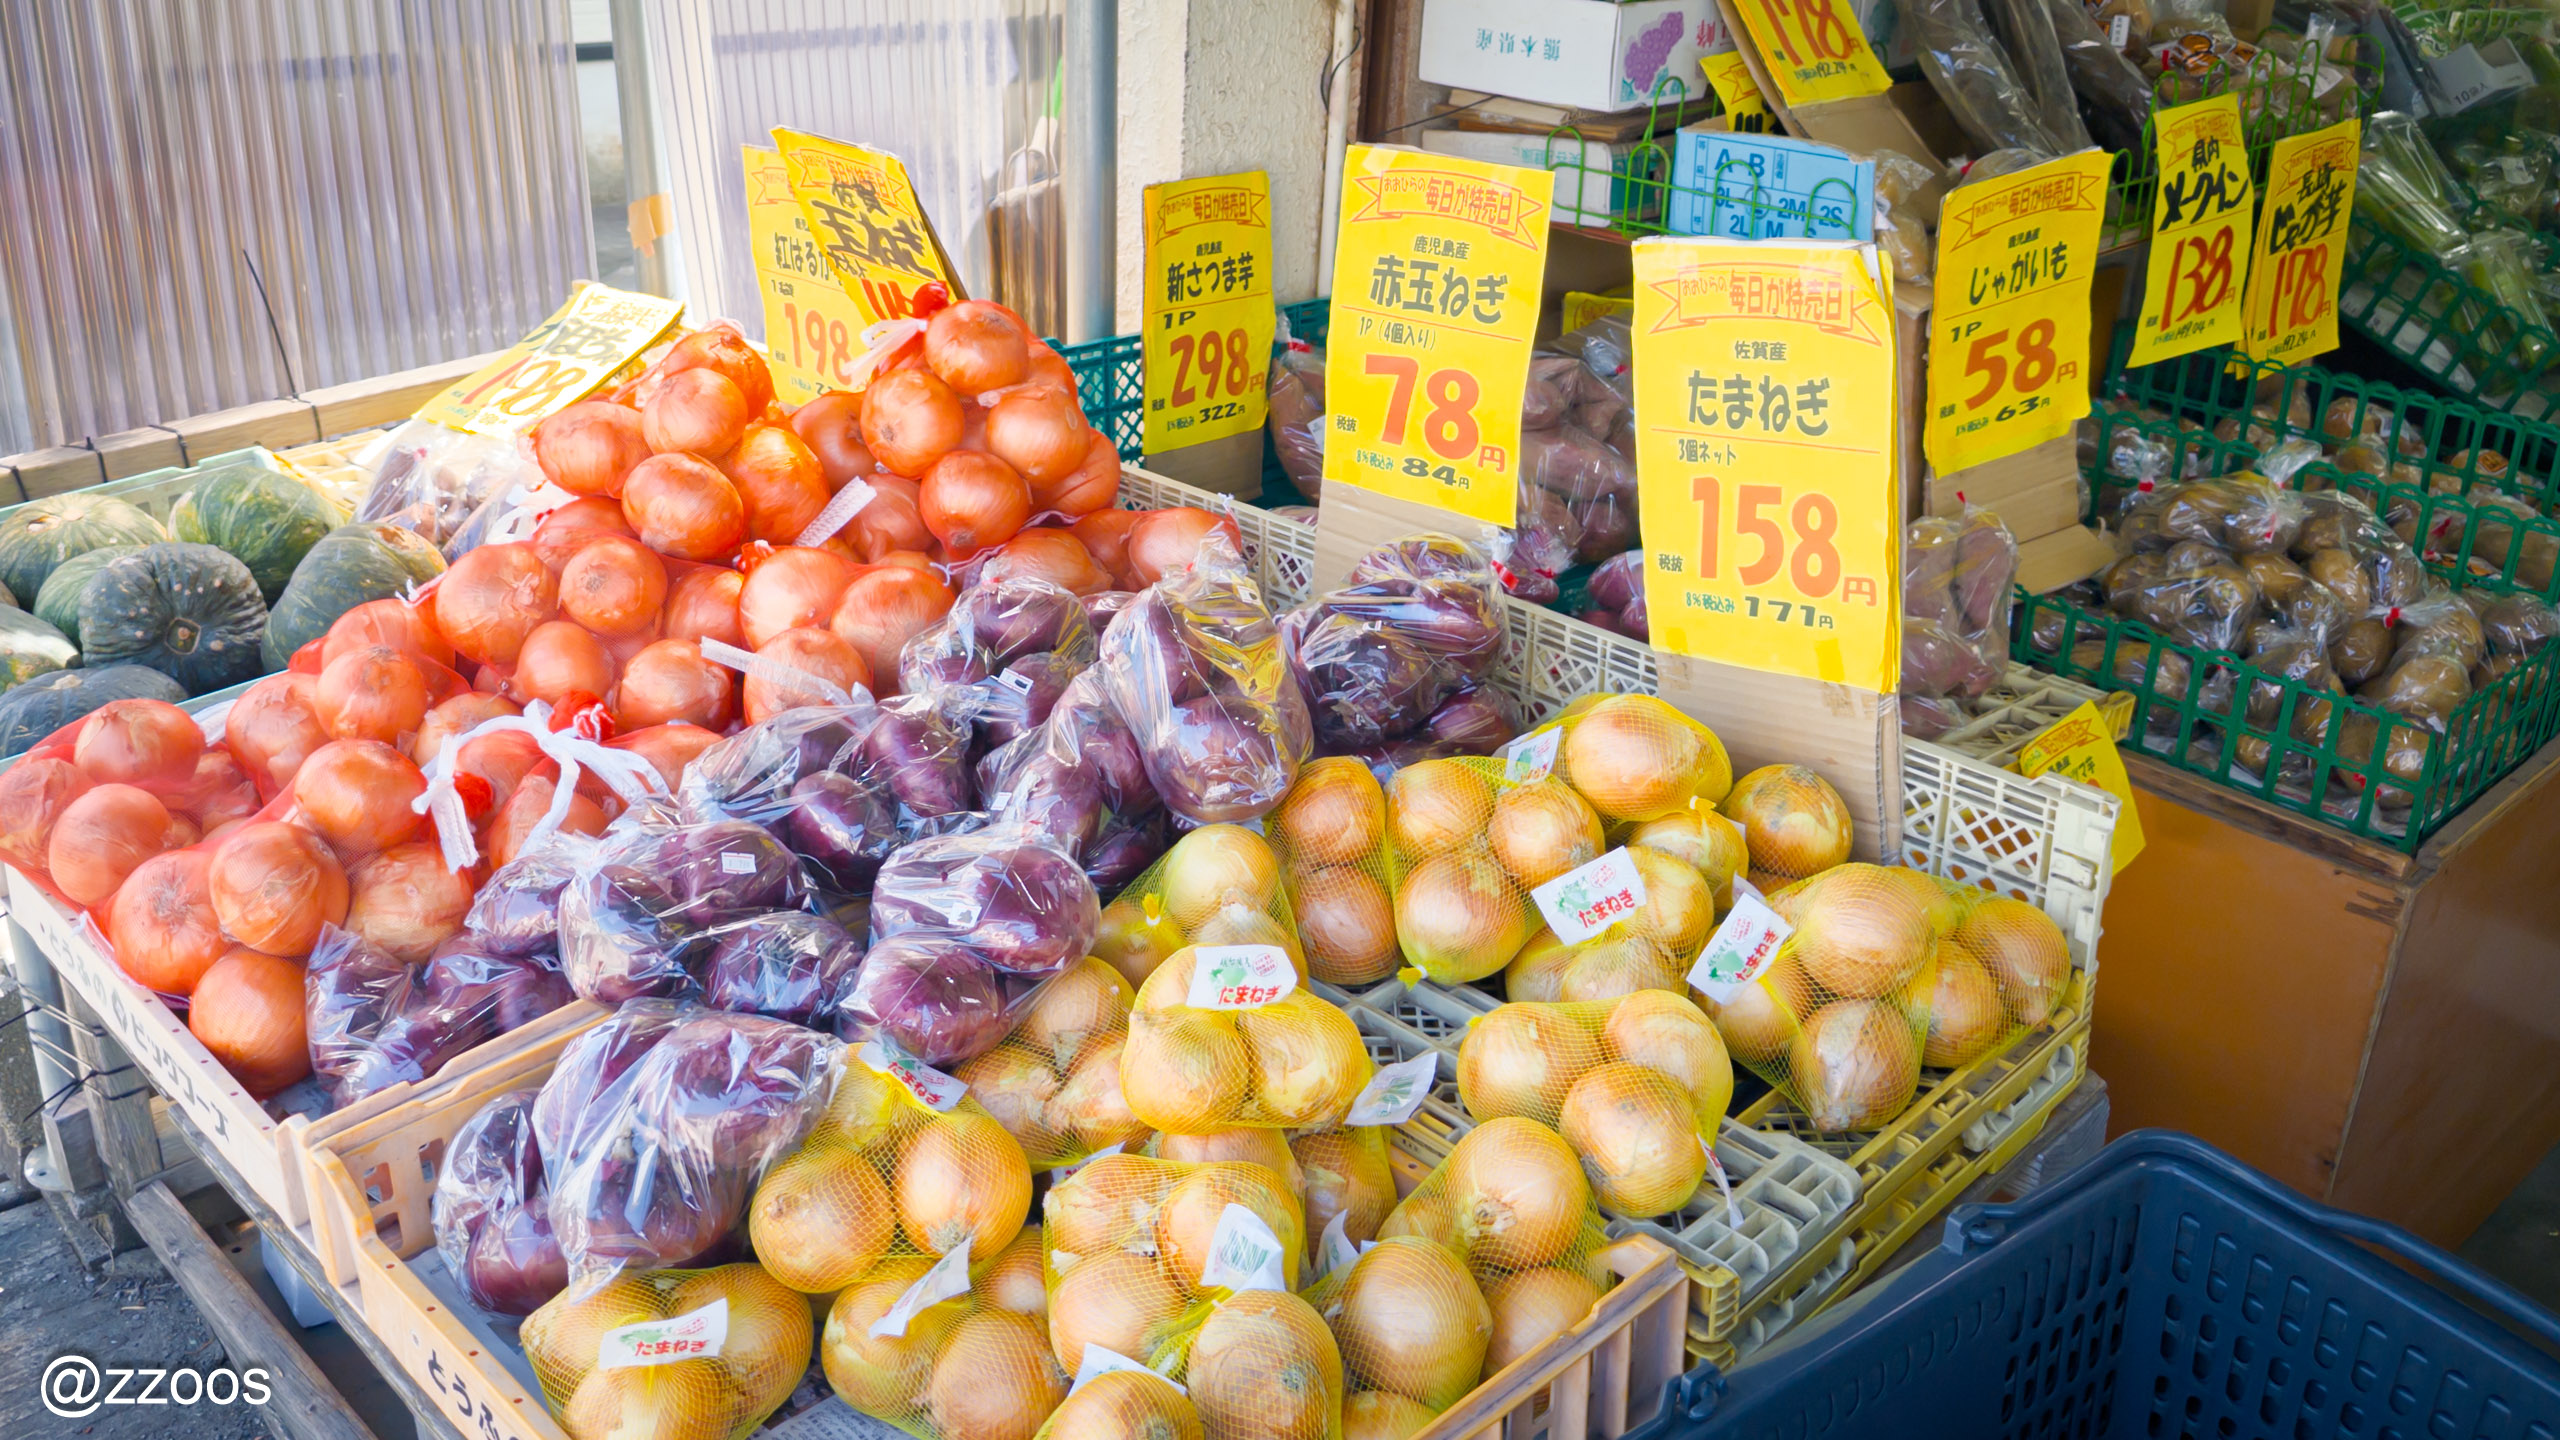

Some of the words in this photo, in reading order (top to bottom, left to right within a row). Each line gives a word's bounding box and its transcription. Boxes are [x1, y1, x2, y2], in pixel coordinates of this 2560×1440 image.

[1475, 28, 1561, 61] 熊本県産
[1413, 235, 1470, 260] 鹿児島産
[1167, 252, 1254, 303] 新さつま芋
[1369, 254, 1508, 325] 赤玉ねぎ
[1969, 241, 2068, 306] じゃがいも
[1734, 341, 1788, 361] 佐賀産
[1688, 370, 1831, 437] たまねぎ
[1336, 415, 1358, 433] 税抜
[1678, 438, 1737, 466] 3個ネット
[1658, 554, 1683, 573] 税抜
[1578, 887, 1635, 928] たまねぎ
[1735, 927, 1778, 981] たまねぎ
[1218, 984, 1281, 1005] たまねぎ
[888, 1061, 944, 1105] たまねぎ
[635, 1340, 708, 1356] たまねぎ
